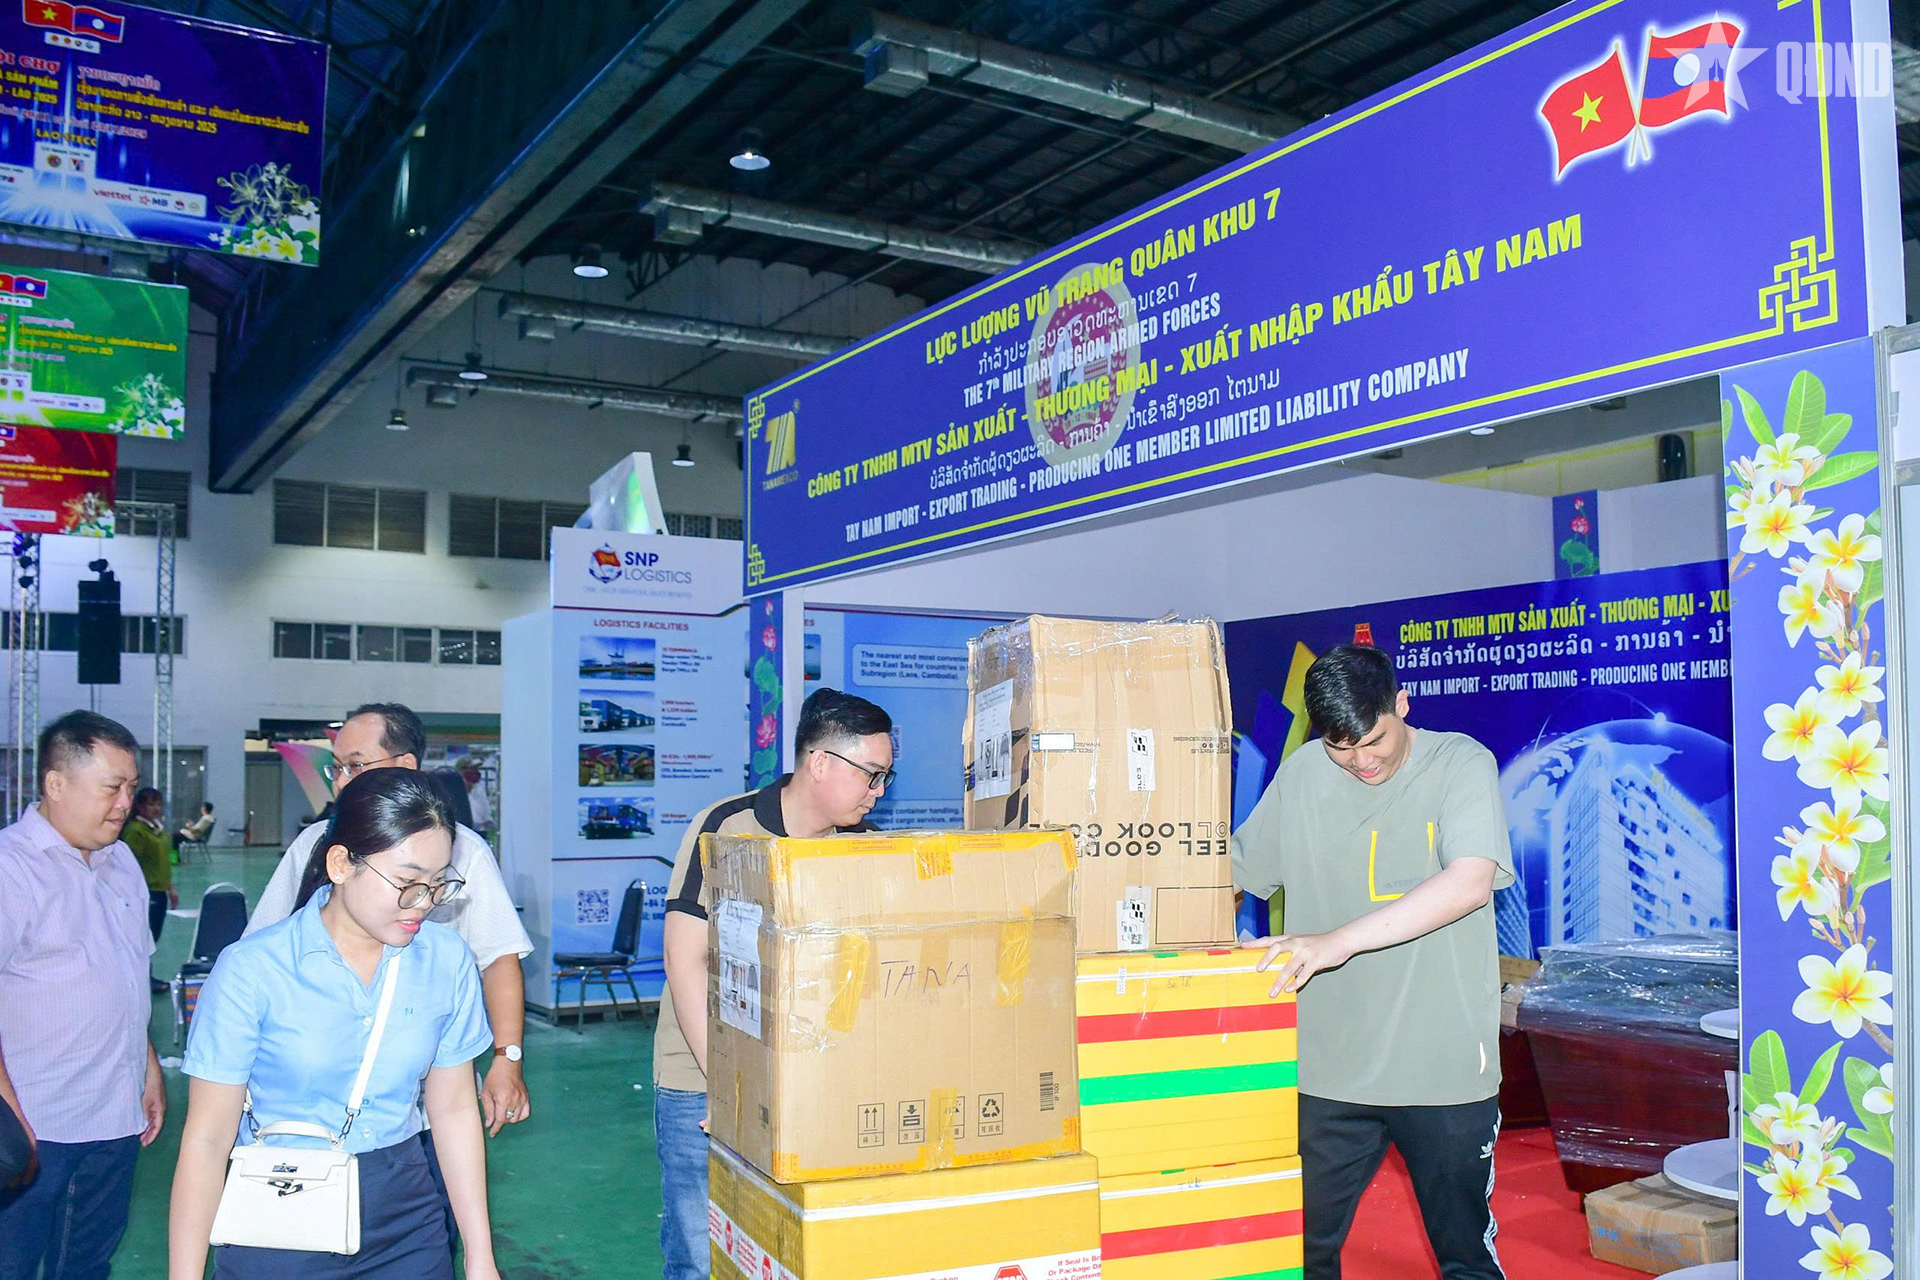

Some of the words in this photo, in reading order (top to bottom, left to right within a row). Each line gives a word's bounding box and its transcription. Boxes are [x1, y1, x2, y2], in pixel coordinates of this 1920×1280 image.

[19, 56, 60, 74] CHỢ
[926, 335, 957, 365] LỰC
[962, 302, 1019, 344] LƯỢNG
[1025, 284, 1050, 321] VŨ
[1057, 258, 1124, 305] TRANG
[1130, 224, 1196, 277] QUÂN
[1203, 198, 1255, 247] KHU
[1264, 187, 1281, 220] 7
[1188, 272, 1198, 292] 7
[807, 471, 841, 498] CÔNG
[844, 465, 859, 486] TY
[862, 449, 897, 481] TNHH
[901, 438, 932, 467] MTV
[936, 422, 969, 457] SẢN
[973, 401, 1016, 442] XUẤT
[1034, 374, 1110, 423] THƯƠNG
[1116, 358, 1157, 395] MẠI
[1180, 324, 1242, 375] XUẤT
[1250, 303, 1323, 353] NHẬP
[1332, 265, 1413, 326] KHẨU
[1423, 246, 1484, 295] TÂY
[1495, 213, 1582, 273] NAM
[964, 386, 983, 408] THE
[1003, 357, 1054, 394] MILITARY
[1059, 334, 1106, 372] REGION
[1110, 315, 1158, 353] ARMED
[1163, 290, 1222, 332] FORCES
[846, 524, 860, 542] TAY
[862, 515, 882, 537] NAM
[884, 505, 919, 533] IMPORT
[929, 491, 967, 521] EXPORT
[971, 478, 1017, 509] TRADING
[1029, 453, 1100, 493] PRODUCING
[1105, 440, 1133, 466] ONE
[1136, 422, 1200, 464] MEMBER
[1205, 402, 1270, 447] LIMITED
[1276, 376, 1361, 427] LIABILITY
[1367, 347, 1469, 397] COMPANY
[624, 552, 659, 566] SNP
[624, 568, 692, 584] LOGISTICS
[594, 619, 640, 629] LOGISTICS
[644, 622, 689, 631] FACILITIES
[1400, 620, 1432, 644] CÔNG
[1435, 620, 1449, 640] TY
[1452, 616, 1485, 638] TNHH
[1488, 612, 1515, 634] MTV
[1518, 603, 1546, 632] SẢN
[1550, 598, 1586, 628] XUẤT
[1599, 597, 1659, 624] THƯƠNG
[1663, 593, 1694, 621] MẠI
[861, 651, 873, 659] The
[876, 652, 901, 660] nearest
[870, 660, 880, 668] the
[883, 661, 898, 669] East
[928, 663, 957, 671] countries
[861, 670, 897, 679] Subregion
[1402, 682, 1418, 698] TAY
[1420, 679, 1441, 697] NAM
[1443, 676, 1480, 694] IMPORT
[1490, 672, 1529, 692] EXPORT
[1531, 669, 1578, 690] TRADING
[1591, 664, 1658, 685] PRODUCING
[1662, 662, 1686, 681] ONE
[1117, 822, 1192, 839] LOOK
[880, 960, 972, 998] TANA
[1059, 1265, 1090, 1275] Package
[1065, 1257, 1080, 1266] Seal
